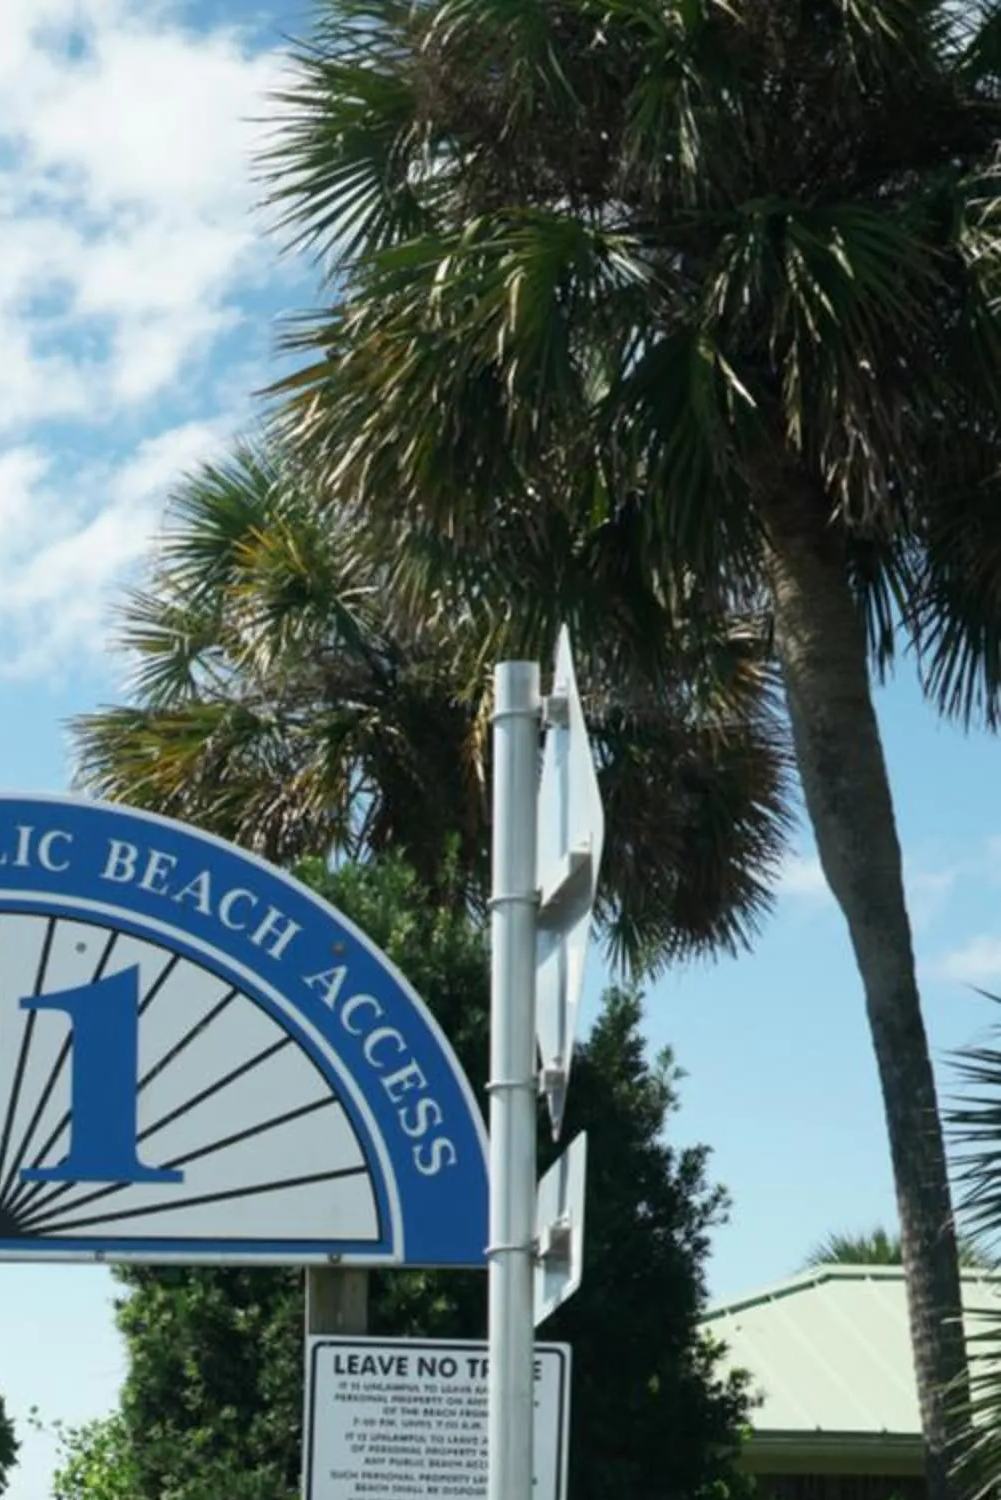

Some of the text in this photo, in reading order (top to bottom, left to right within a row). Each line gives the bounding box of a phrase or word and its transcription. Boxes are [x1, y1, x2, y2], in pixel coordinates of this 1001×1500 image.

[100, 839, 304, 961] BEACH
[303, 964, 458, 1177] ACCESS
[333, 1354, 409, 1377] LEAVE
[417, 1357, 458, 1378] NO
